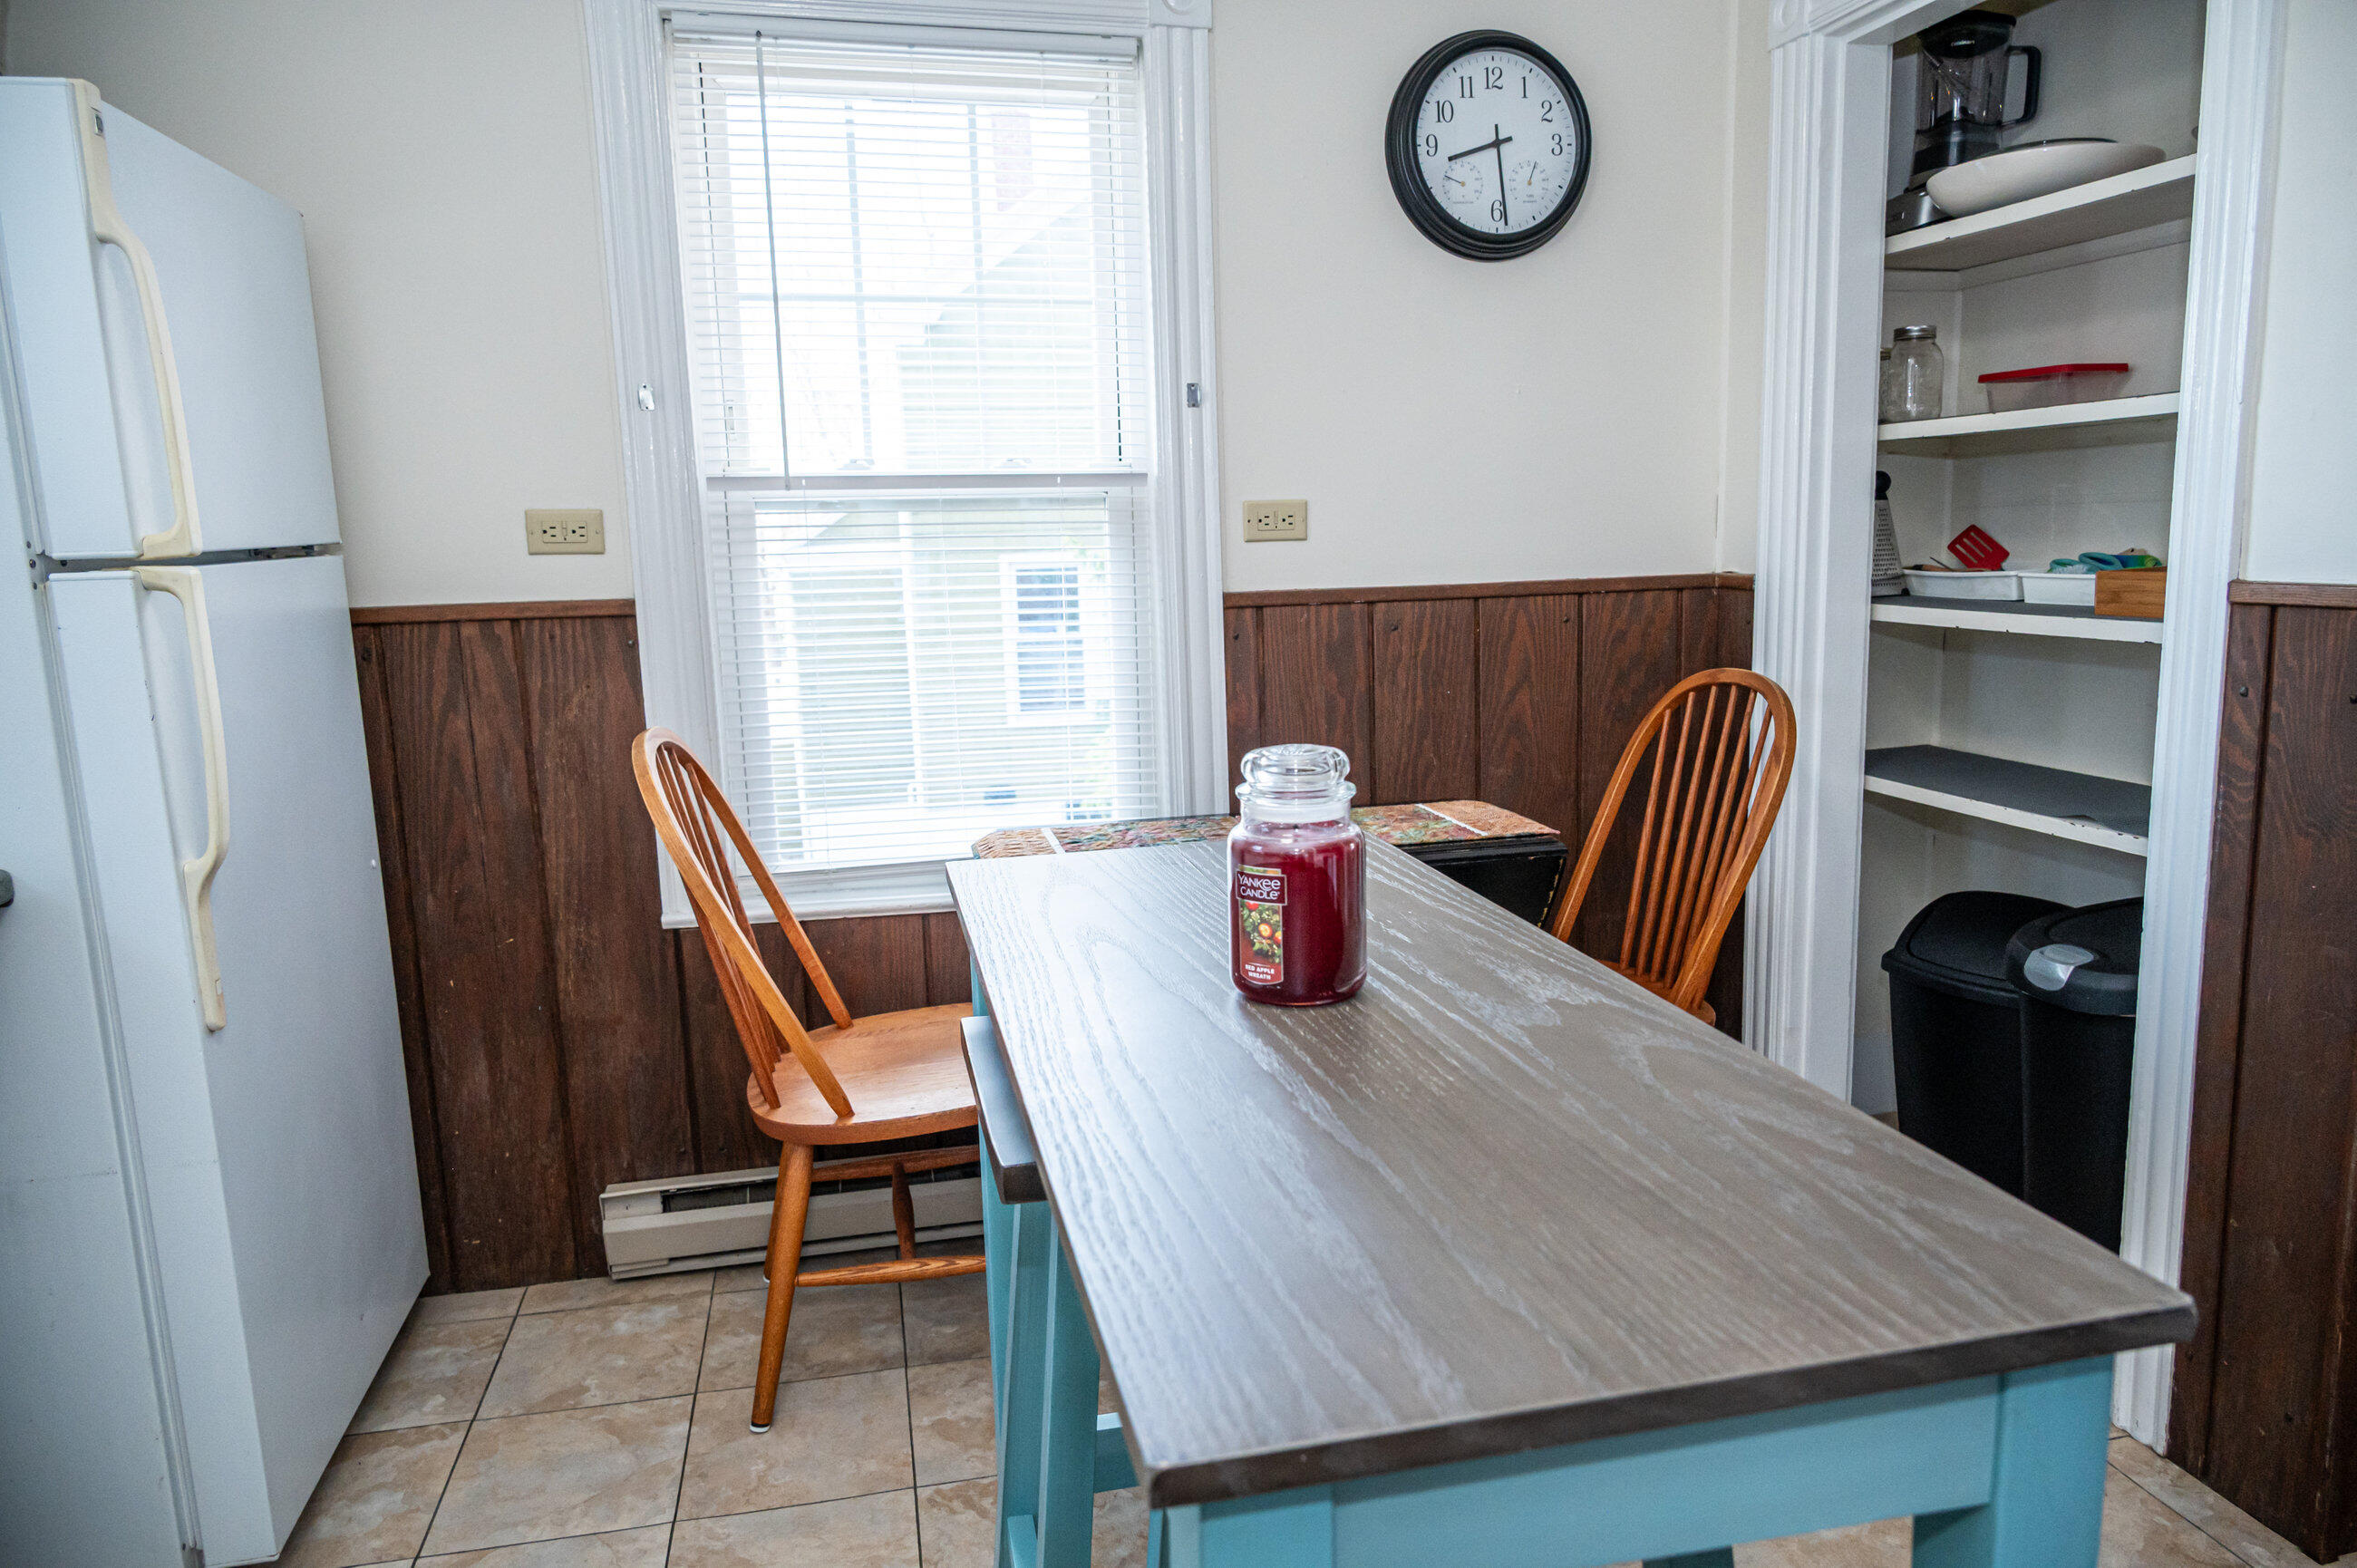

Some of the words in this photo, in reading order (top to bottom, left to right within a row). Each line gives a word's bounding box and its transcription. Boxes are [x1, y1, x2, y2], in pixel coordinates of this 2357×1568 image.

[1459, 75, 1475, 99] 11
[1483, 66, 1504, 91] 12
[1520, 75, 1528, 99] 1
[1435, 100, 1454, 123] 10
[1540, 100, 1553, 123] 2
[1425, 134, 1439, 157] 9
[1551, 133, 1563, 156] 3
[1490, 199, 1503, 223] 6
